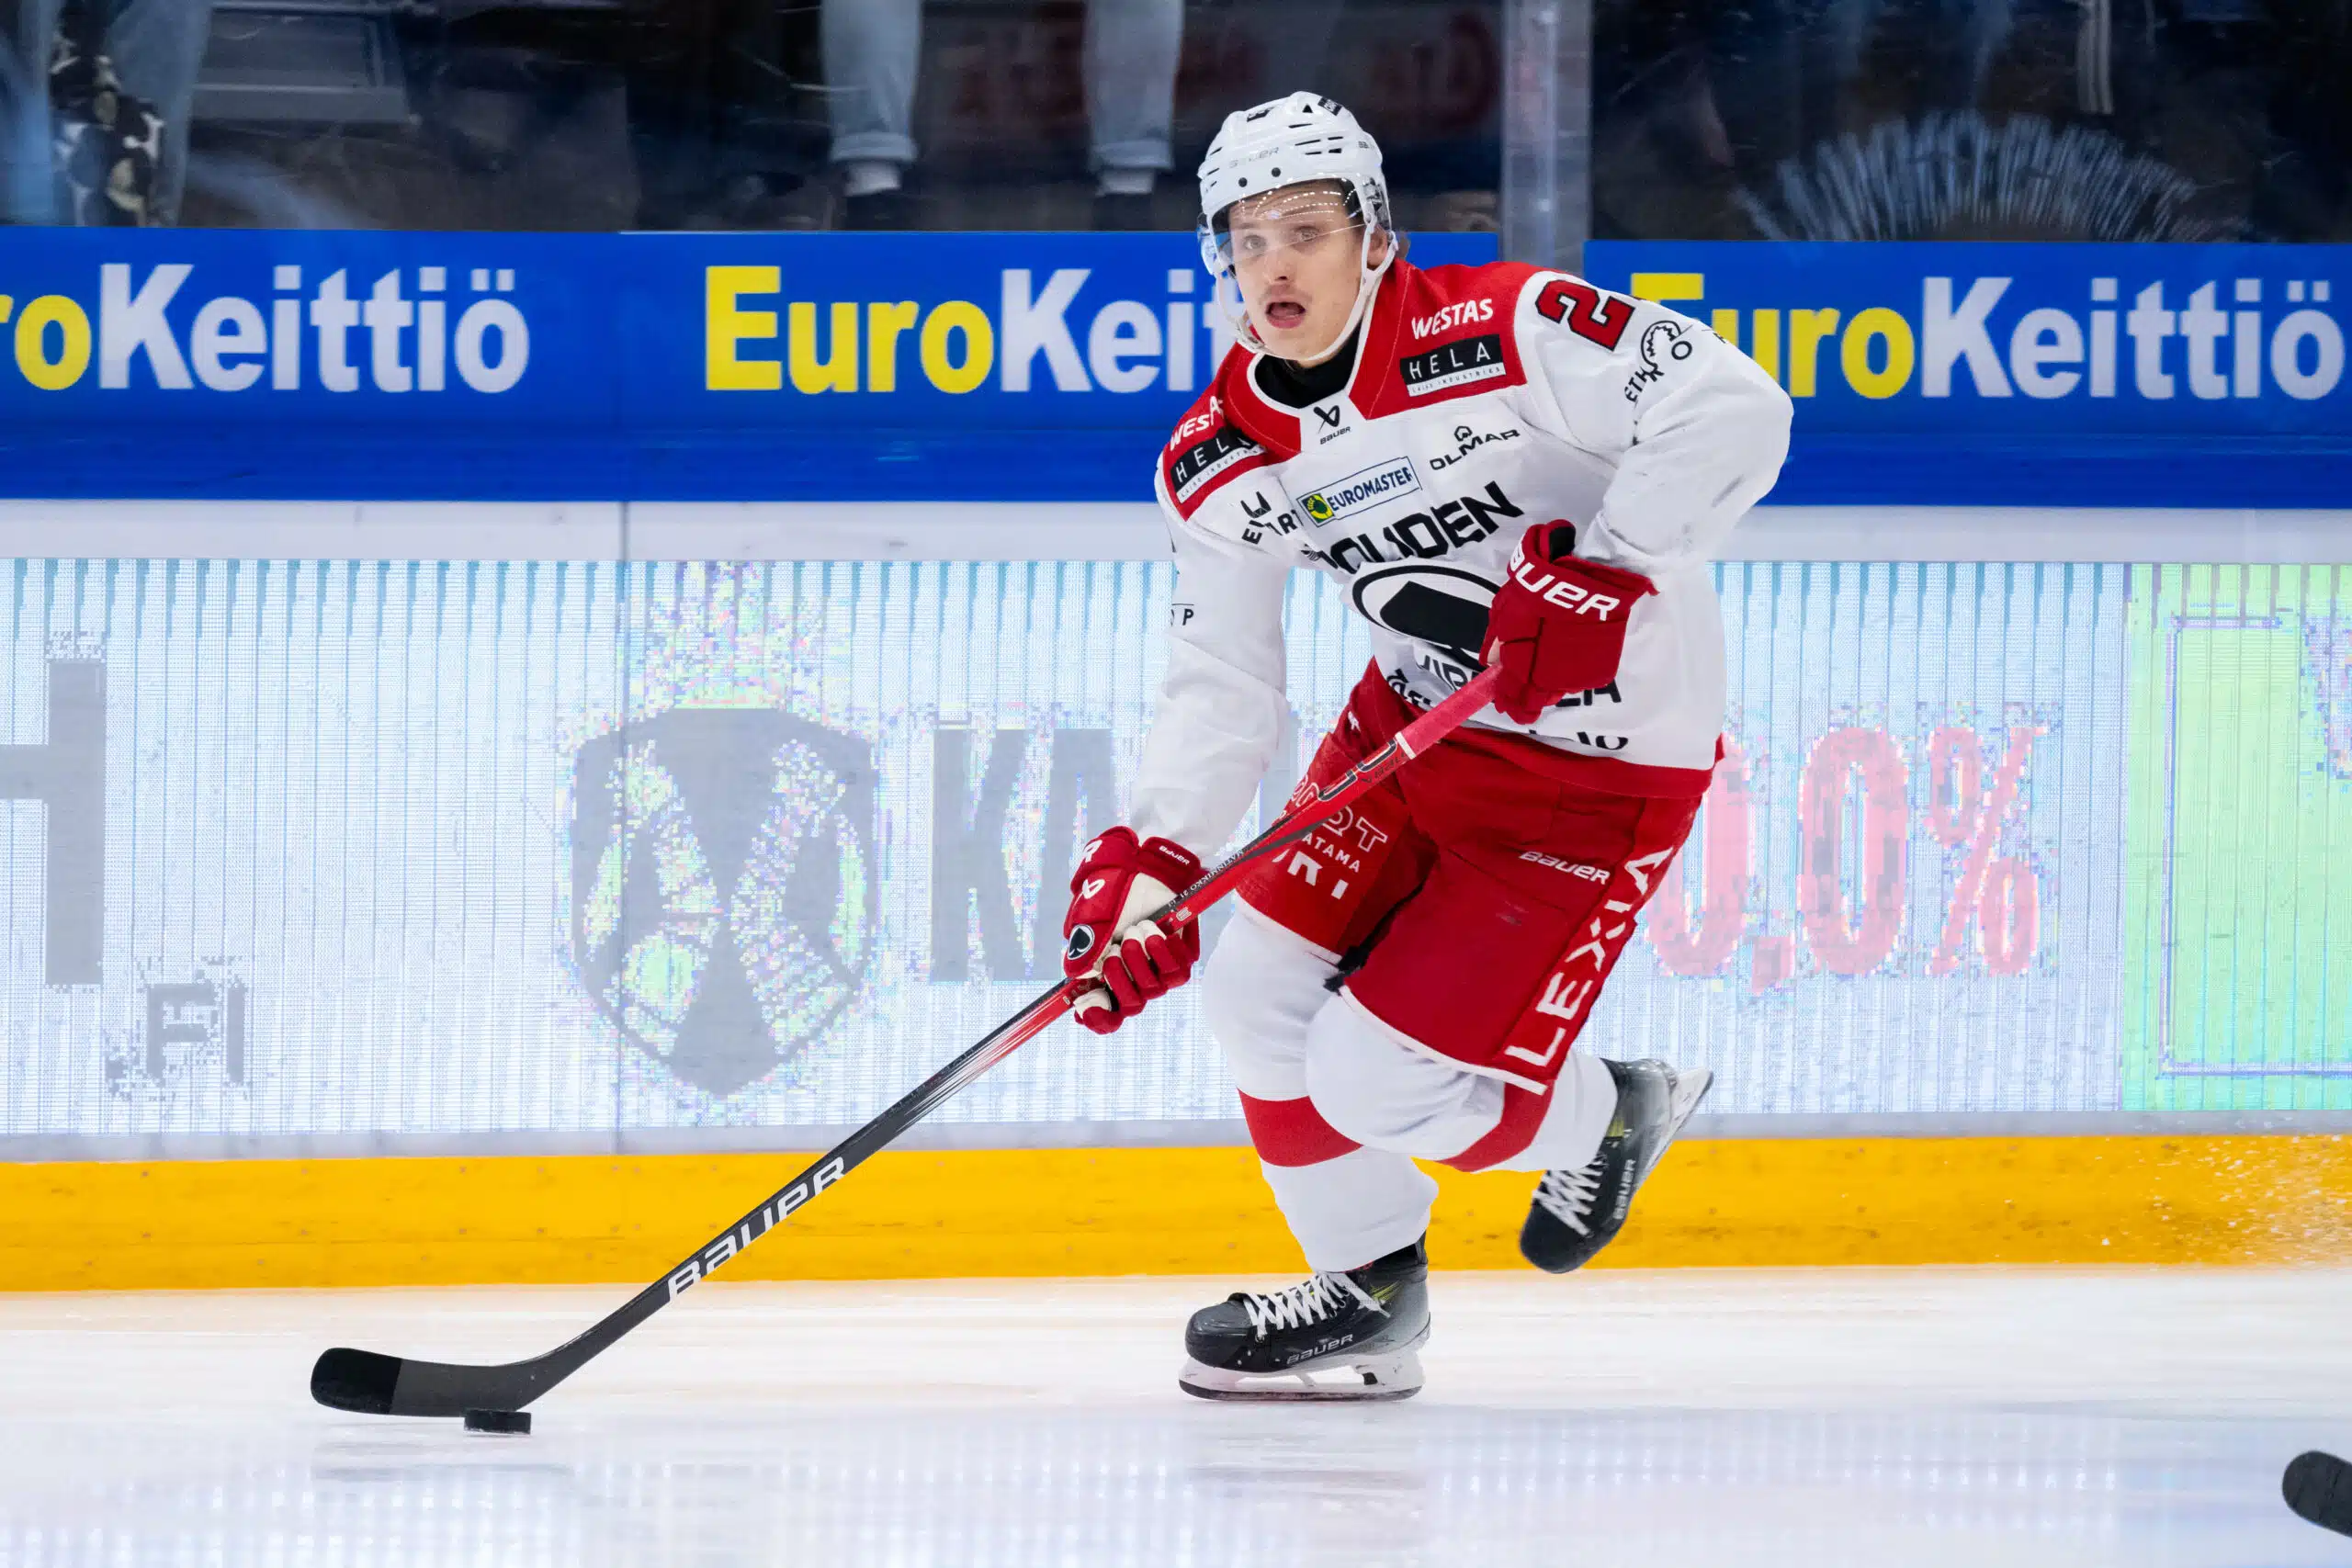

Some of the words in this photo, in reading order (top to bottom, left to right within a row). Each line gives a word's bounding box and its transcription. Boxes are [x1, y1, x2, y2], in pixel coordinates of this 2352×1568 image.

[0, 263, 530, 394] oKeittiö
[706, 265, 1246, 394] EuroKeit
[1411, 298, 1494, 340] WESTAS
[1534, 278, 1636, 352] 2
[1408, 341, 1492, 380] HELA
[1319, 426, 1351, 445] BAUER
[1430, 429, 1521, 470] OLMAR
[1327, 466, 1413, 512] EUROMASTER
[1510, 546, 1621, 622] AUER
[1159, 845, 1191, 865] BAUER
[1302, 831, 1361, 874] ATAMA
[1519, 851, 1611, 885] BAUER
[667, 1156, 845, 1303] BAUER
[1286, 1333, 1354, 1365] BAUER
